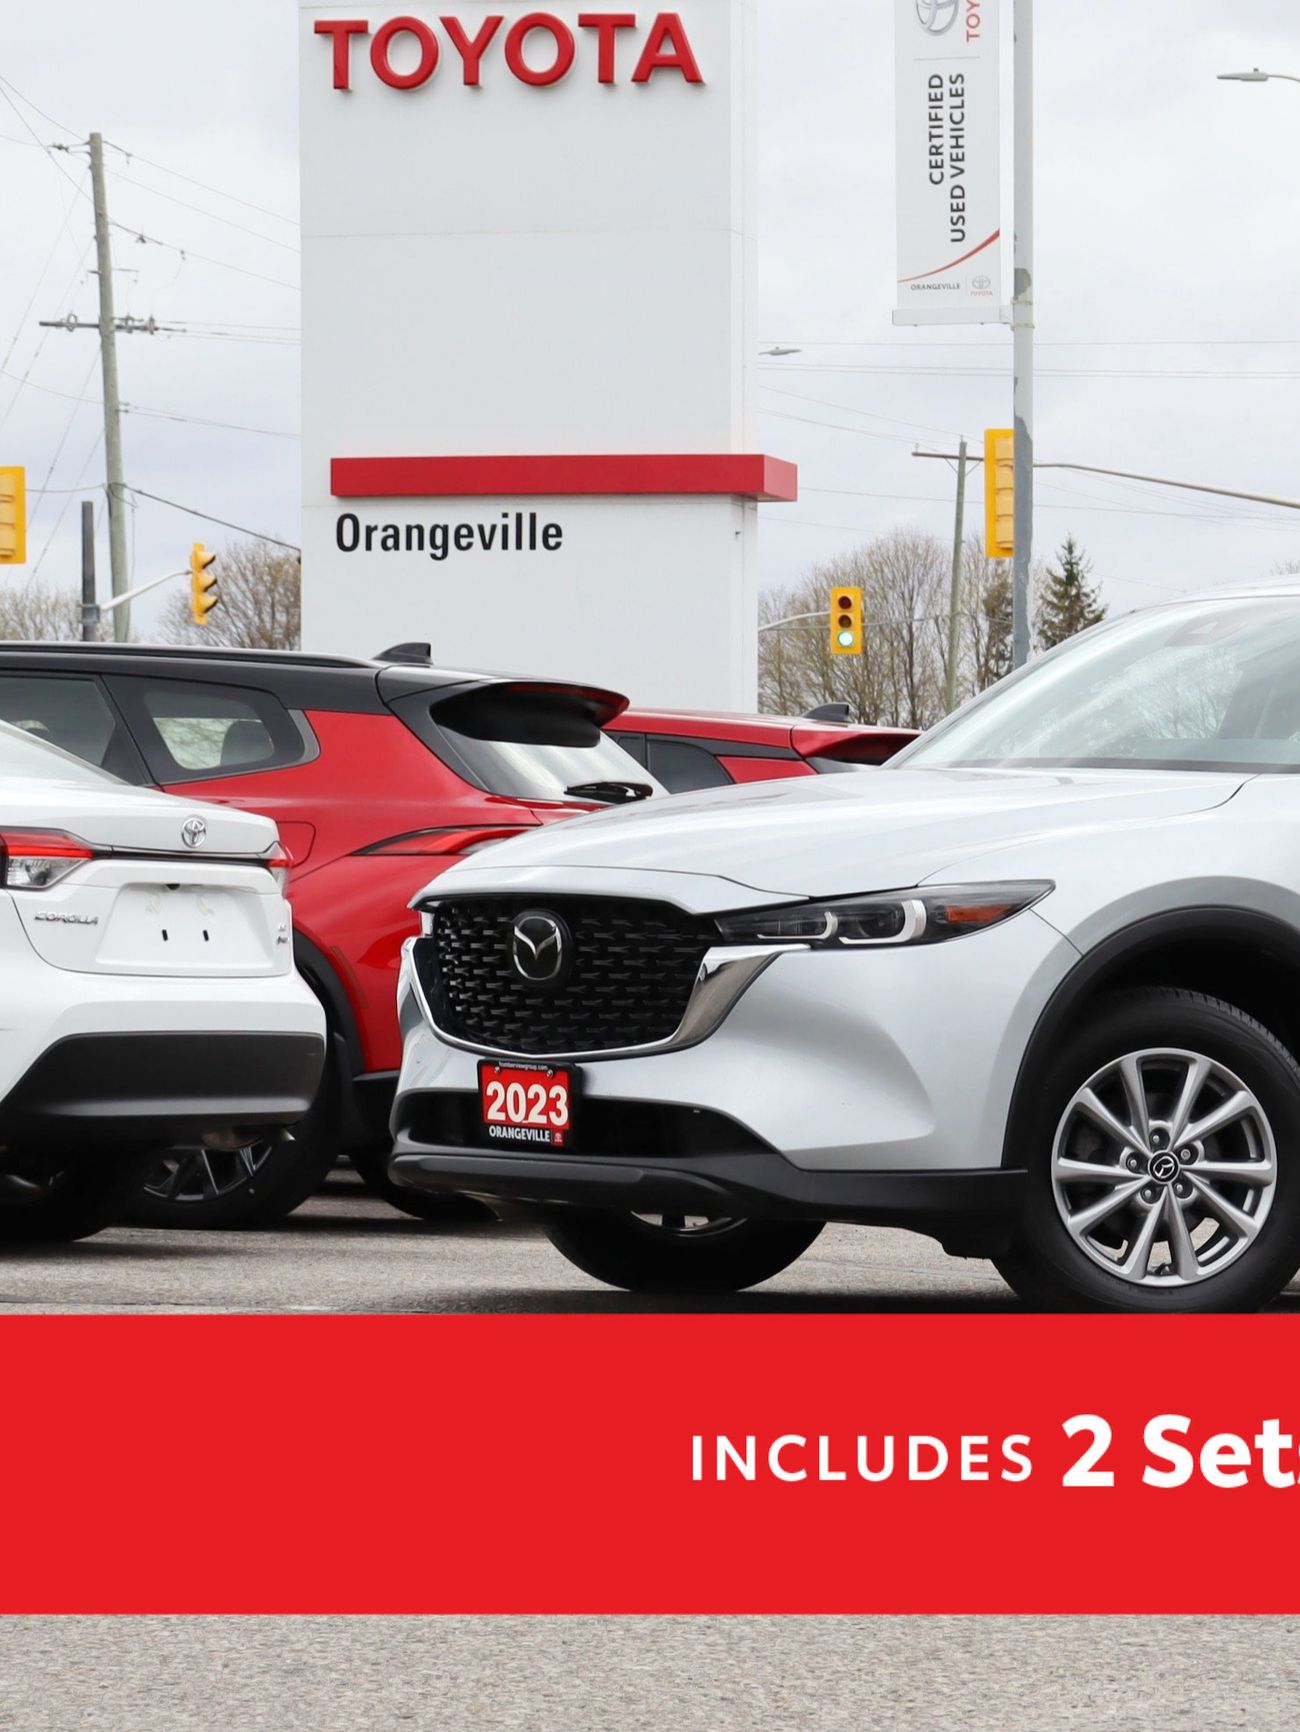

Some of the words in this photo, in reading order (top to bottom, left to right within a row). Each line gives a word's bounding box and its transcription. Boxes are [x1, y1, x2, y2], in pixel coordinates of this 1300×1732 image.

[315, 12, 704, 90] TOYOTA
[928, 74, 944, 186] CERTIFIED
[949, 73, 965, 179] VEHICLES
[950, 184, 966, 243] USED
[911, 283, 961, 291] ORANGEVILLE
[336, 511, 563, 561] Orangeville
[33, 911, 99, 925] COROLLA
[486, 1081, 569, 1127] 2023
[489, 1125, 551, 1142] ORANGEVILLE
